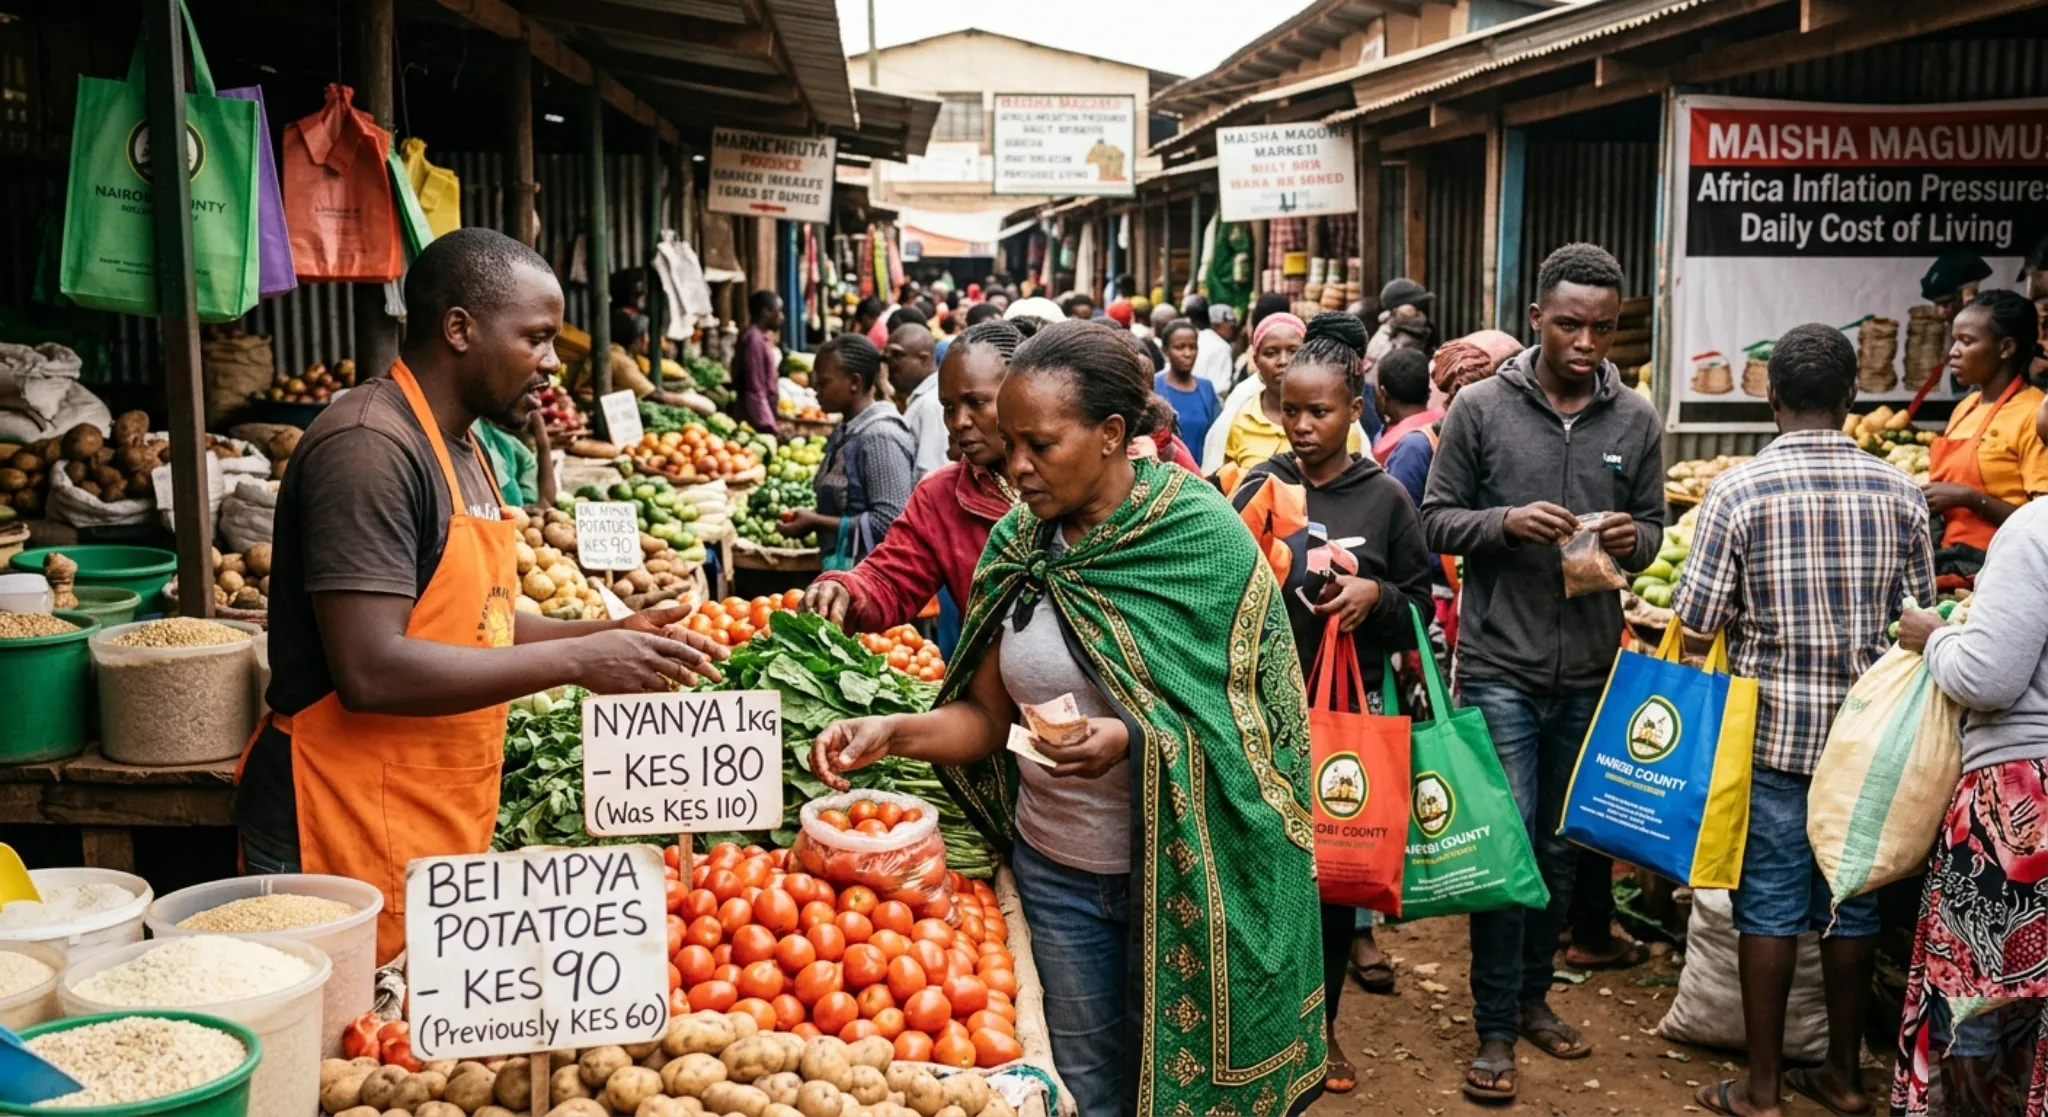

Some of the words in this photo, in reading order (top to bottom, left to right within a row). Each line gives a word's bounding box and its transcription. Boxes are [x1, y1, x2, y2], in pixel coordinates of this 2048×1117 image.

[1708, 122, 1858, 160] MAISHA
[1868, 121, 2048, 161] MAGUMU
[1697, 172, 1784, 202] Africa
[1793, 172, 1912, 202] Inflation
[1921, 173, 2048, 203] Pressure
[1740, 212, 1813, 249] Daily
[1820, 212, 1885, 242] Cost
[1892, 213, 1921, 242] of
[1929, 212, 2013, 248] Living
[611, 536, 632, 553] 90
[593, 697, 726, 740] NYANYA
[625, 752, 690, 790] KES
[701, 743, 764, 787] 180
[1635, 768, 1687, 791] COUNTY
[594, 794, 655, 830] (Was
[664, 798, 709, 824] KES
[717, 789, 758, 824] 110)
[427, 860, 499, 908] BEI
[523, 852, 640, 897] MPYA
[434, 899, 648, 958] POTATOES
[464, 966, 544, 1009] KES
[552, 948, 621, 1002] 90
[419, 1008, 560, 1057] (Previously
[571, 1007, 619, 1035] KES
[626, 993, 668, 1038] 60)
